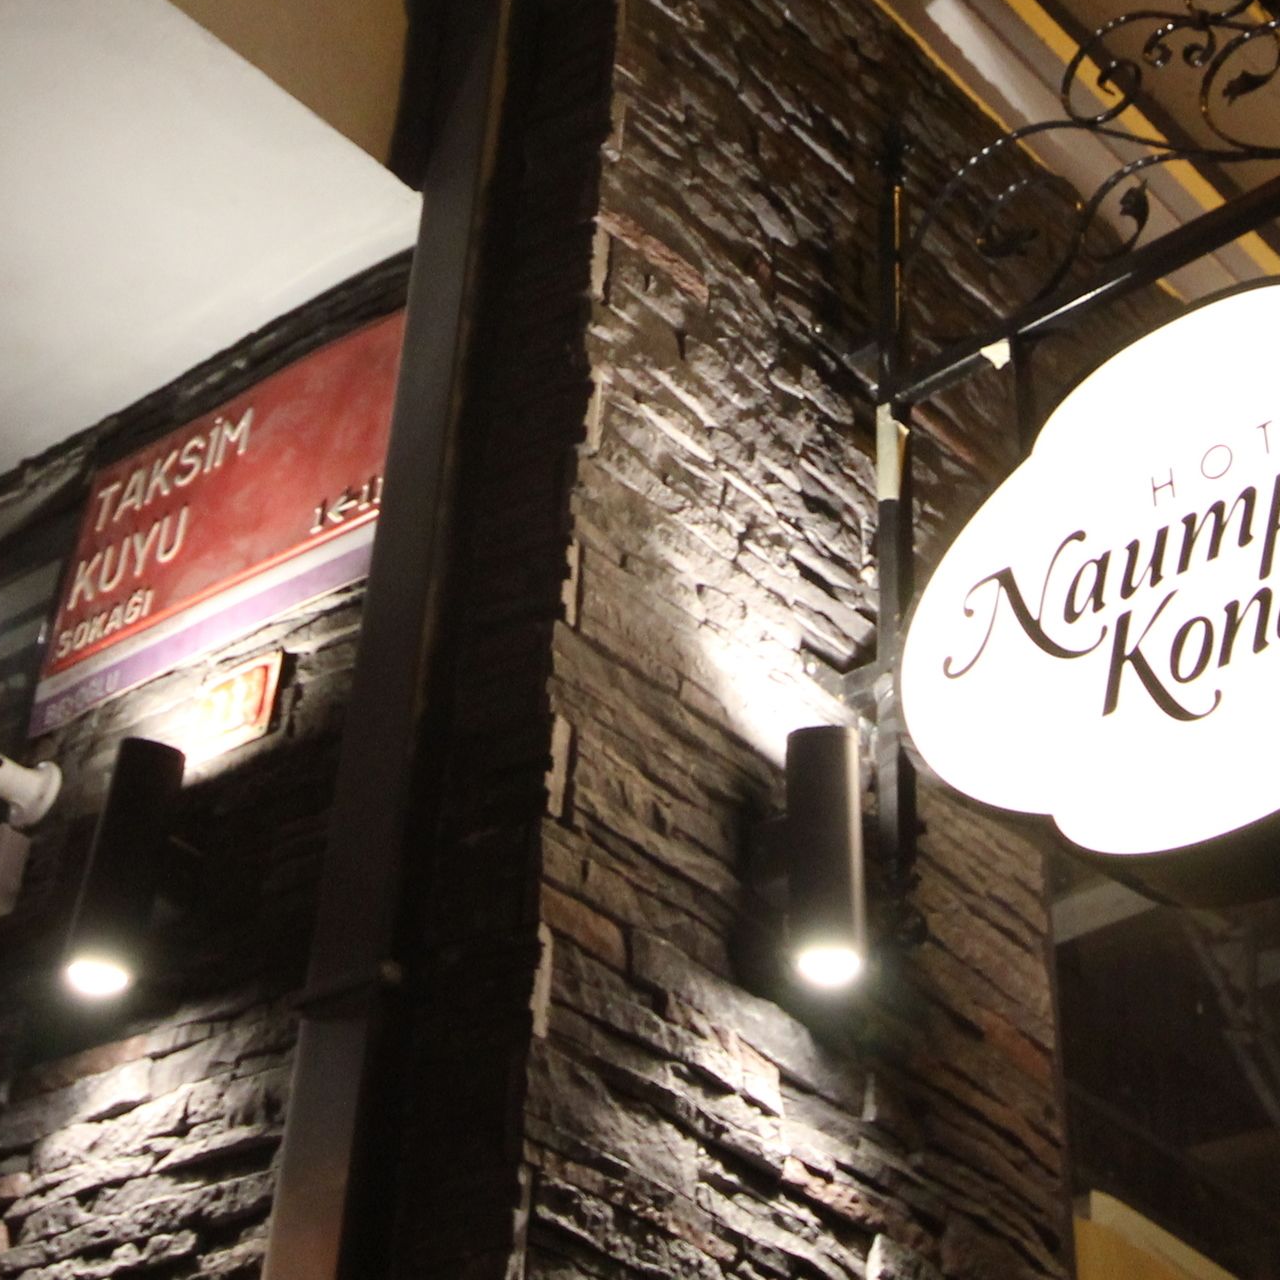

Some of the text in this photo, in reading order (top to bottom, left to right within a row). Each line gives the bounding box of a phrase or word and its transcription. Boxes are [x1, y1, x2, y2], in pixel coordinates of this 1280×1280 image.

[96, 407, 254, 532] TAKSİM
[67, 506, 190, 611] KUYU
[57, 588, 155, 658] SOKAĞI
